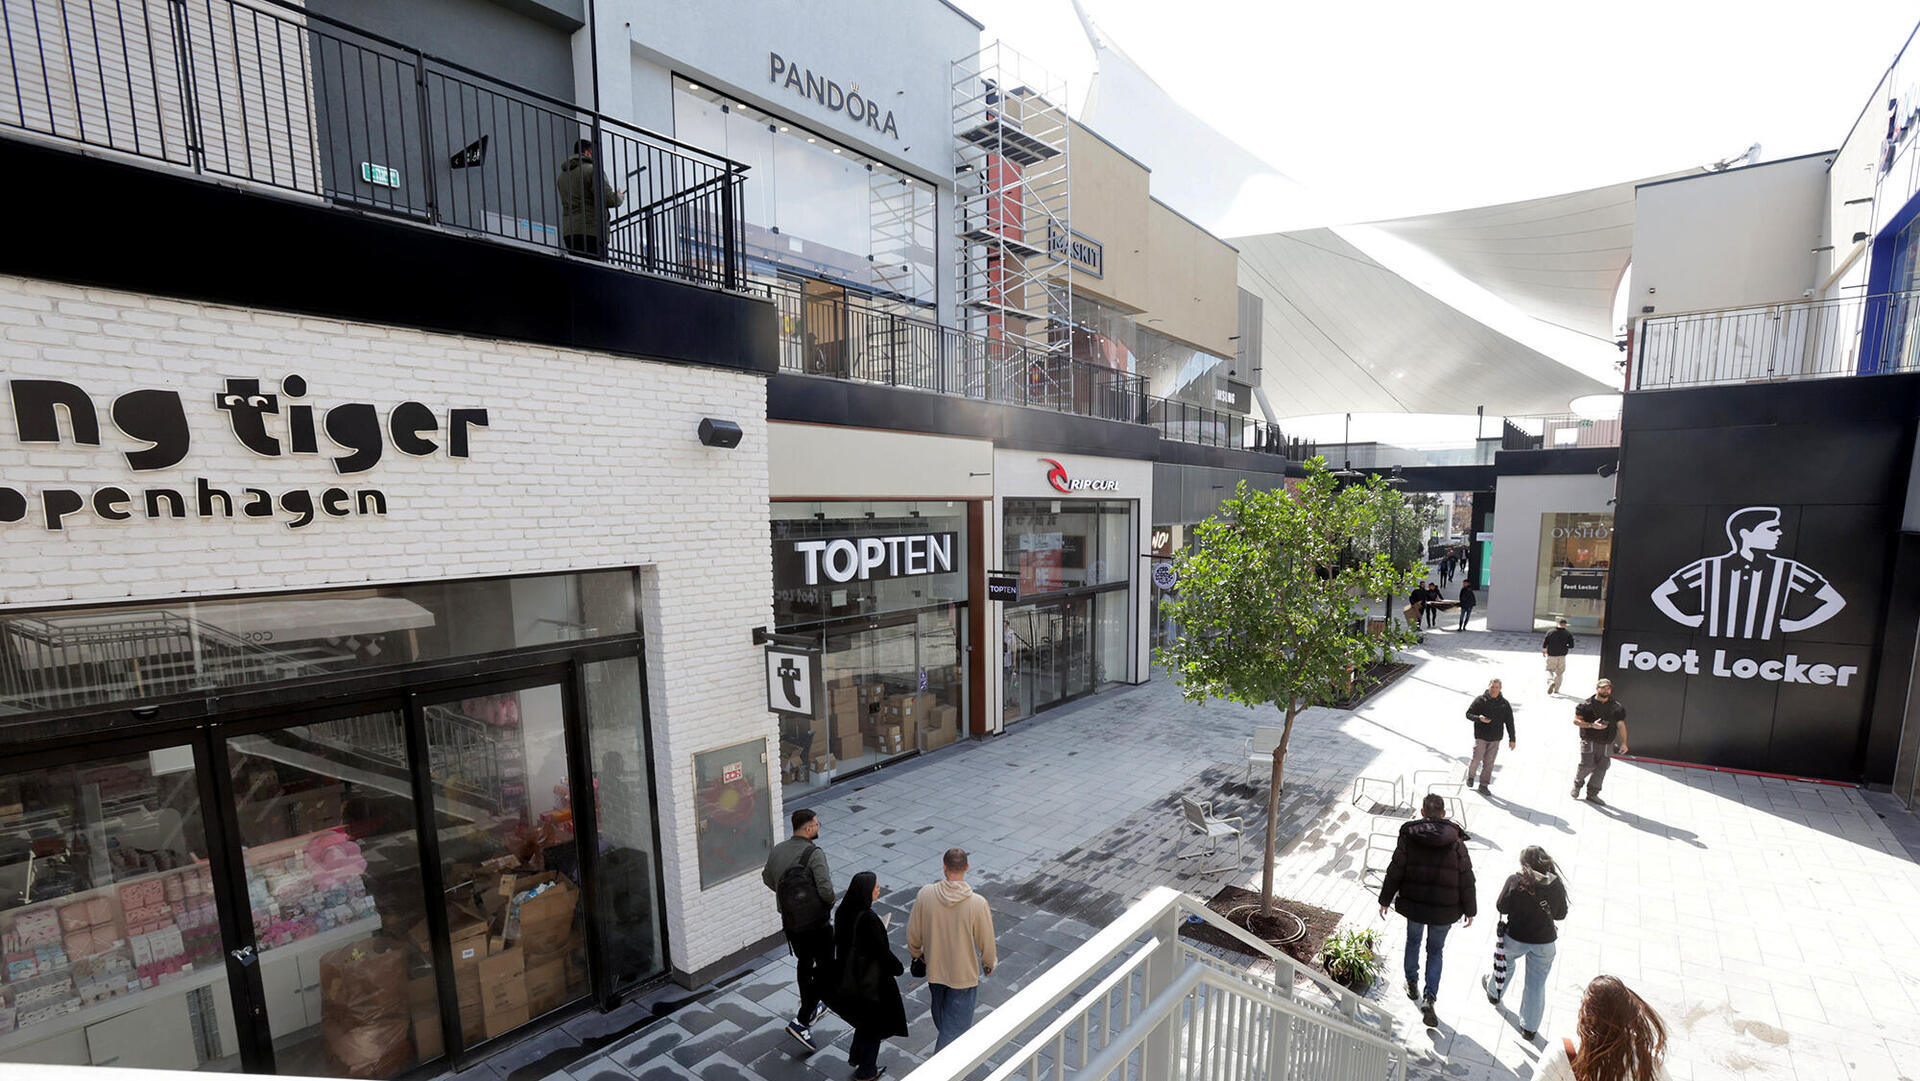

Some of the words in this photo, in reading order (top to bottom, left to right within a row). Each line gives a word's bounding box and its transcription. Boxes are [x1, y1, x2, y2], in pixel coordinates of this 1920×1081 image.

[770, 51, 899, 140] PANDORA
[1052, 230, 1100, 267] MASKIT
[213, 373, 489, 475] tiger
[794, 534, 951, 585] TOPTEN
[990, 585, 1017, 594] TOPTEN
[1563, 583, 1577, 591] Foot
[1578, 583, 1600, 591] Locker
[1618, 643, 1700, 675] Foot
[1712, 649, 1858, 687] Locker
